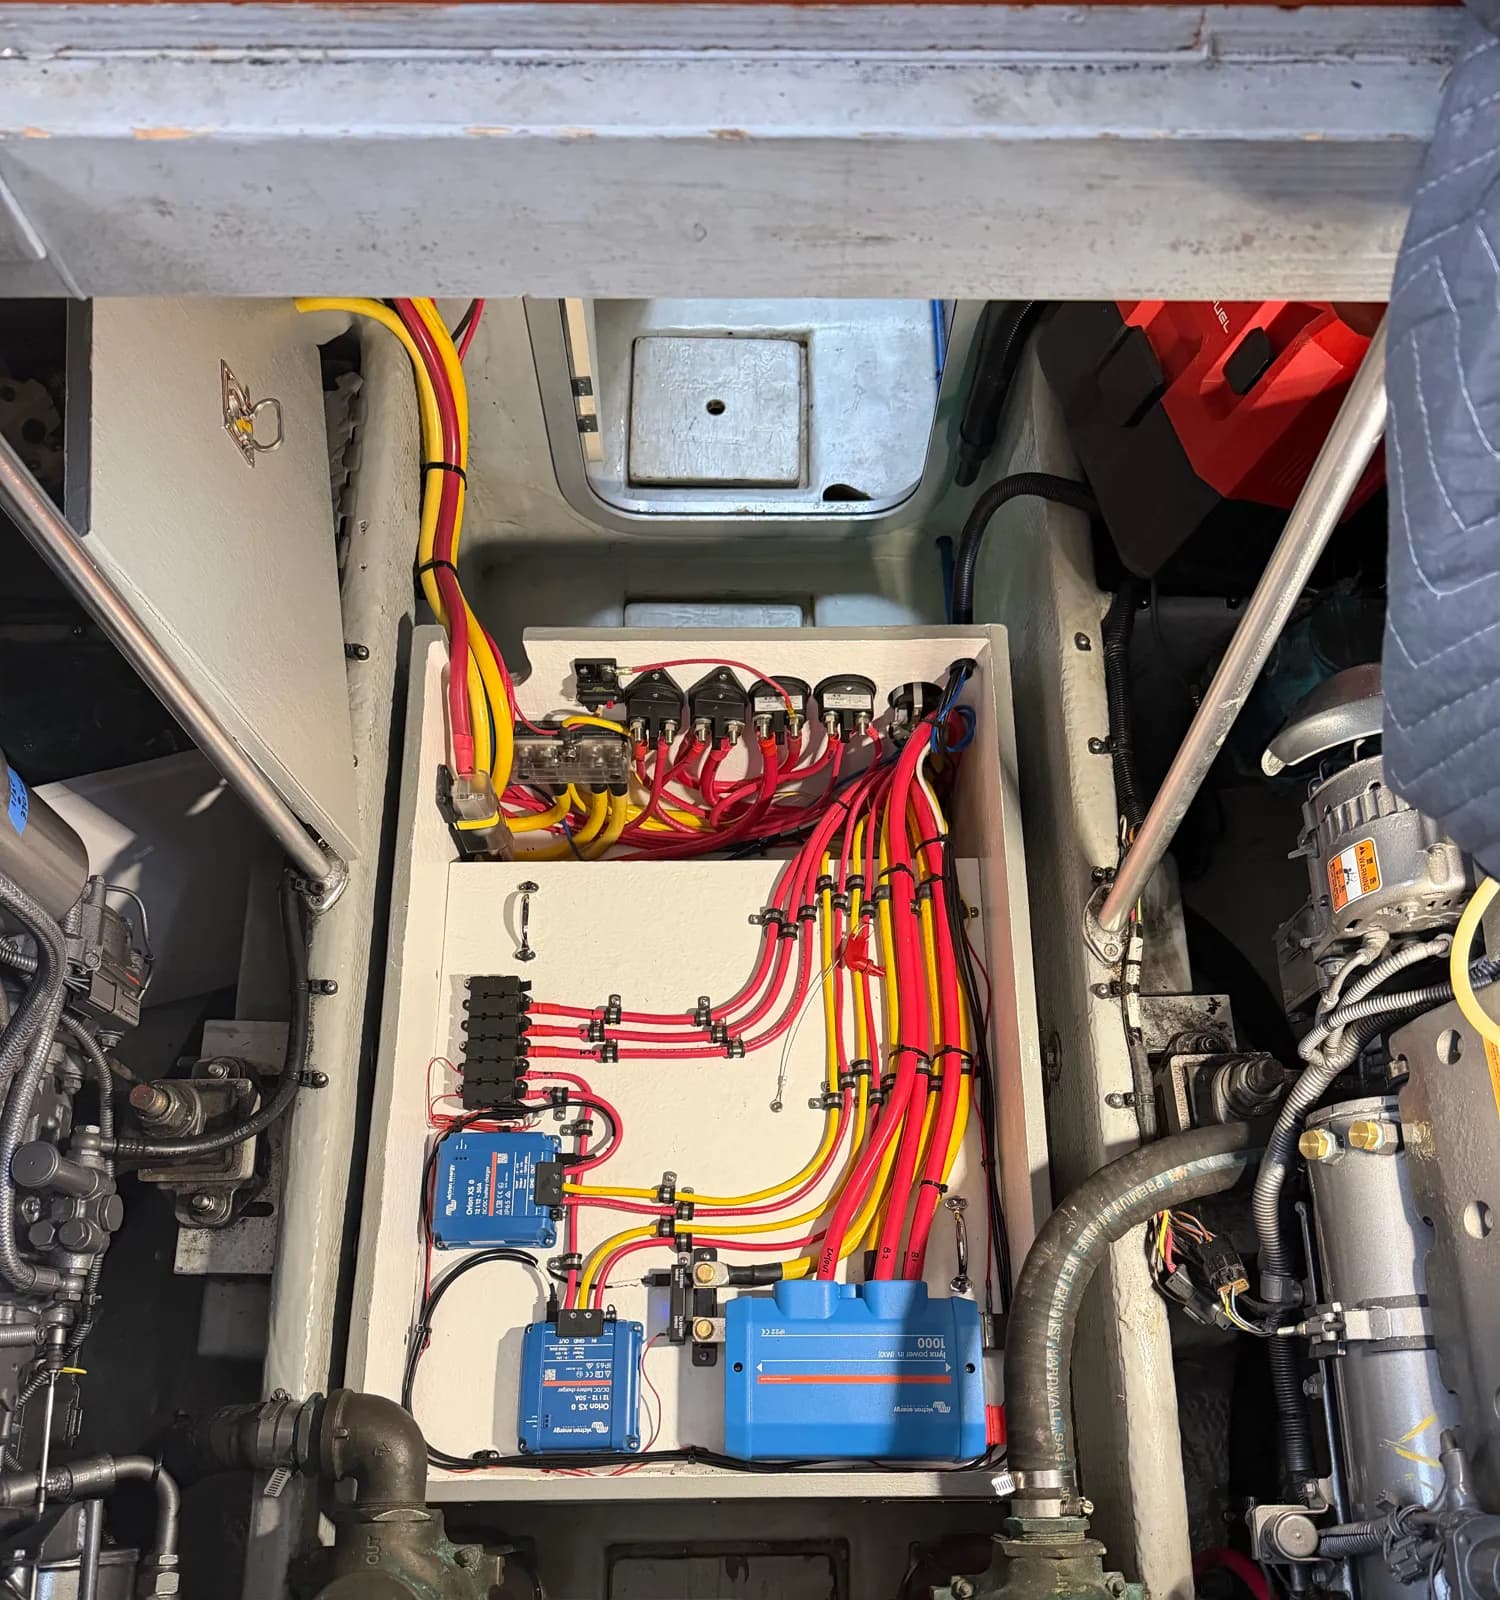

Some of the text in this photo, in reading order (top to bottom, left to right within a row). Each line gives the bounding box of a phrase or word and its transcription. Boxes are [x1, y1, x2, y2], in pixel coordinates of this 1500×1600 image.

[1213, 301, 1230, 334] UEL
[1358, 856, 1370, 892] WARNING
[466, 1186, 475, 1215] Orion XS
[1074, 1212, 1112, 1254] MARINE
[1047, 1283, 1070, 1344] EXHAUST
[917, 1337, 946, 1349] 1000
[929, 1350, 946, 1359] lynx
[1046, 1348, 1062, 1429] HARDWALL
[578, 1402, 610, 1411] Orion XS
[1055, 1433, 1066, 1463] SAE
[366, 1535, 381, 1566] OUT
